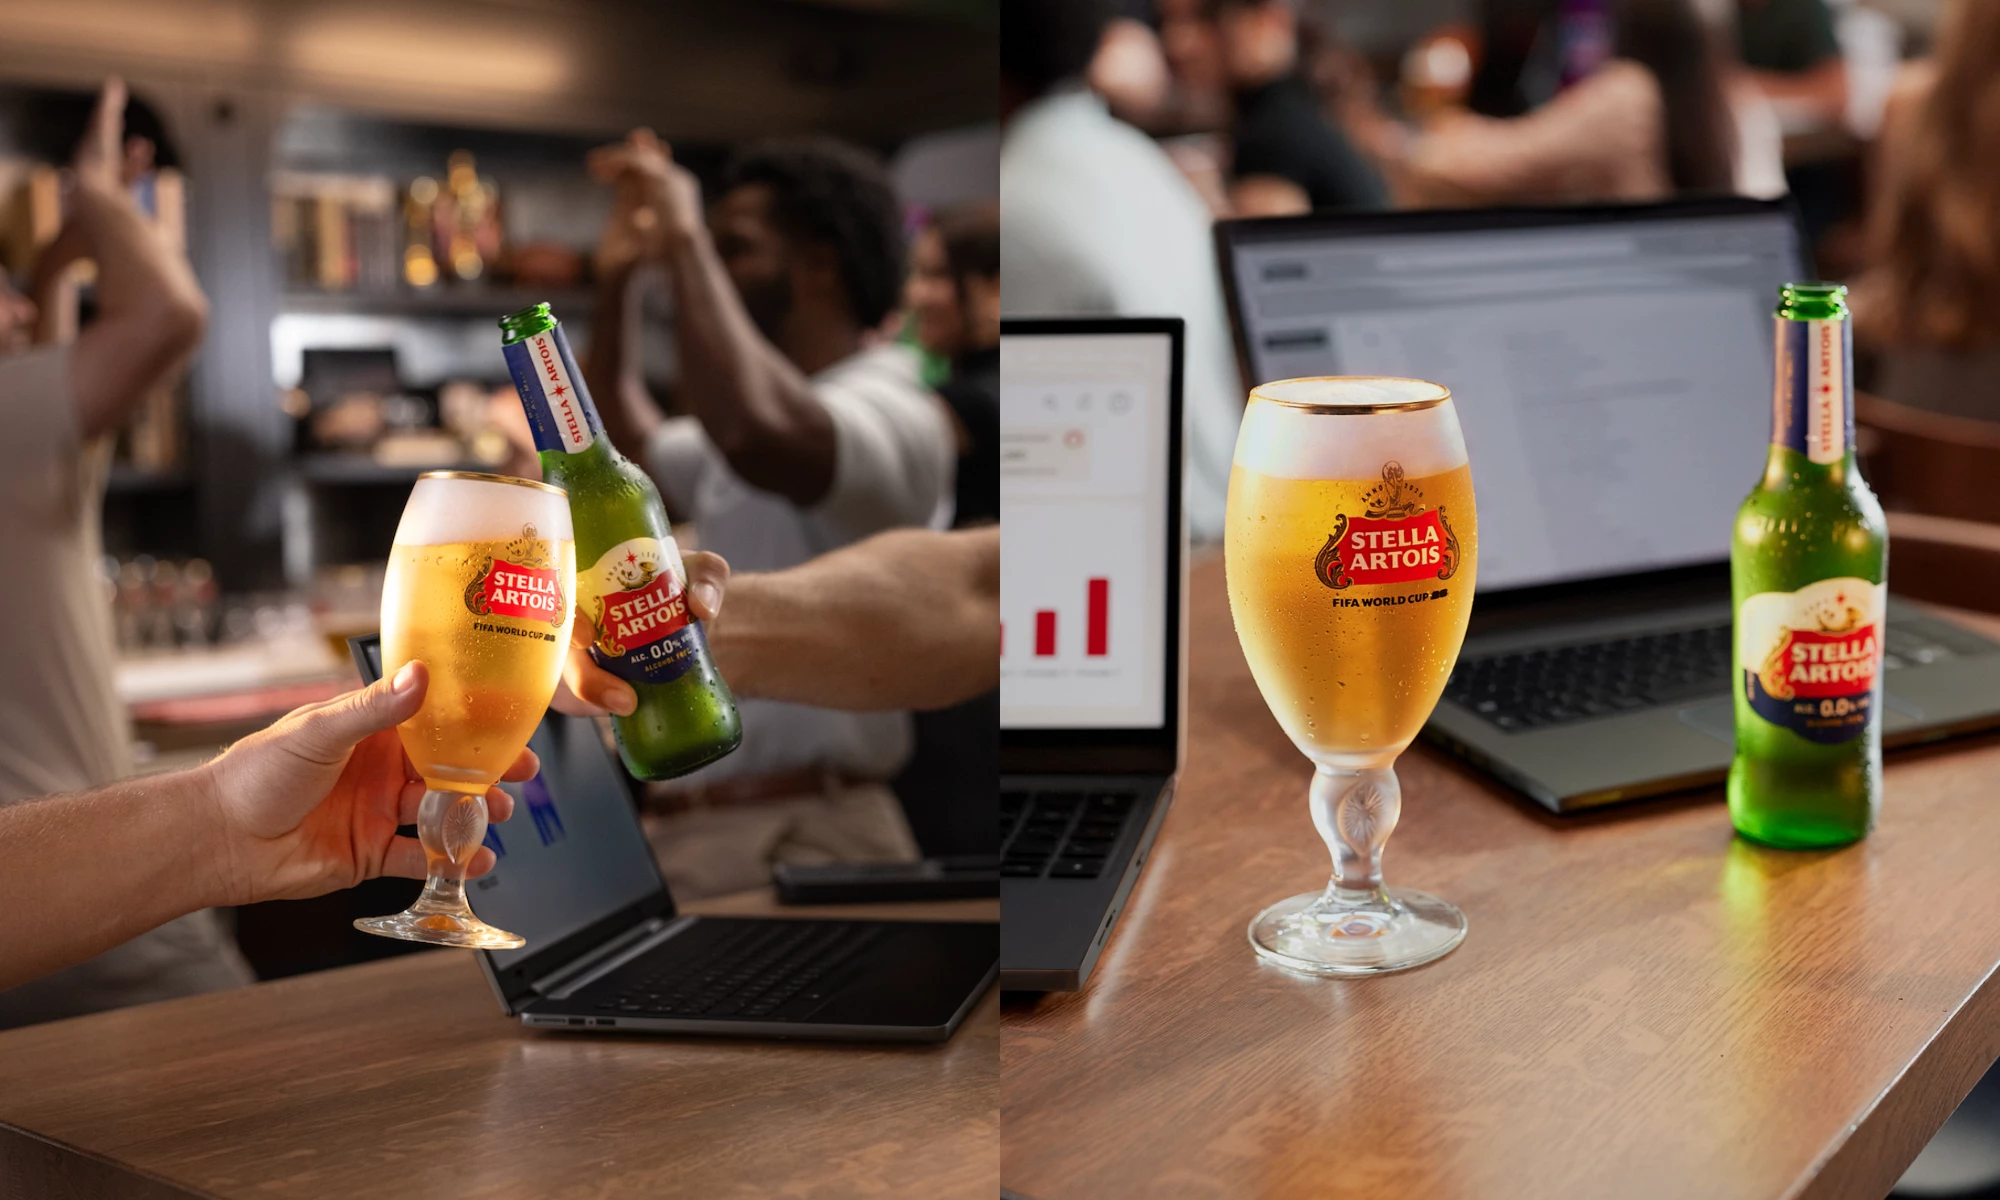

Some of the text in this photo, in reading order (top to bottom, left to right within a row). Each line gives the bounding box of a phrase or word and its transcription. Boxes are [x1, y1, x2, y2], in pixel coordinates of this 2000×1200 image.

[1820, 325, 1832, 452] STELLA ARTOIS
[560, 399, 584, 444] STELLA
[1361, 482, 1424, 503] ANNO 2026
[1351, 525, 1440, 550] STELLA
[1349, 546, 1441, 571] ARTOIS
[493, 571, 556, 595] STELLA
[490, 588, 556, 612] ARTOIS
[609, 581, 681, 622] STELLA
[1332, 598, 1360, 608] FIFA
[1361, 596, 1407, 608] WORLD
[1407, 592, 1429, 604] CUP
[473, 622, 495, 633] FIFA
[495, 625, 528, 637] WORLD
[528, 630, 544, 640] CUP
[617, 598, 686, 639] ARTOIS
[1790, 636, 1877, 663] STELLA
